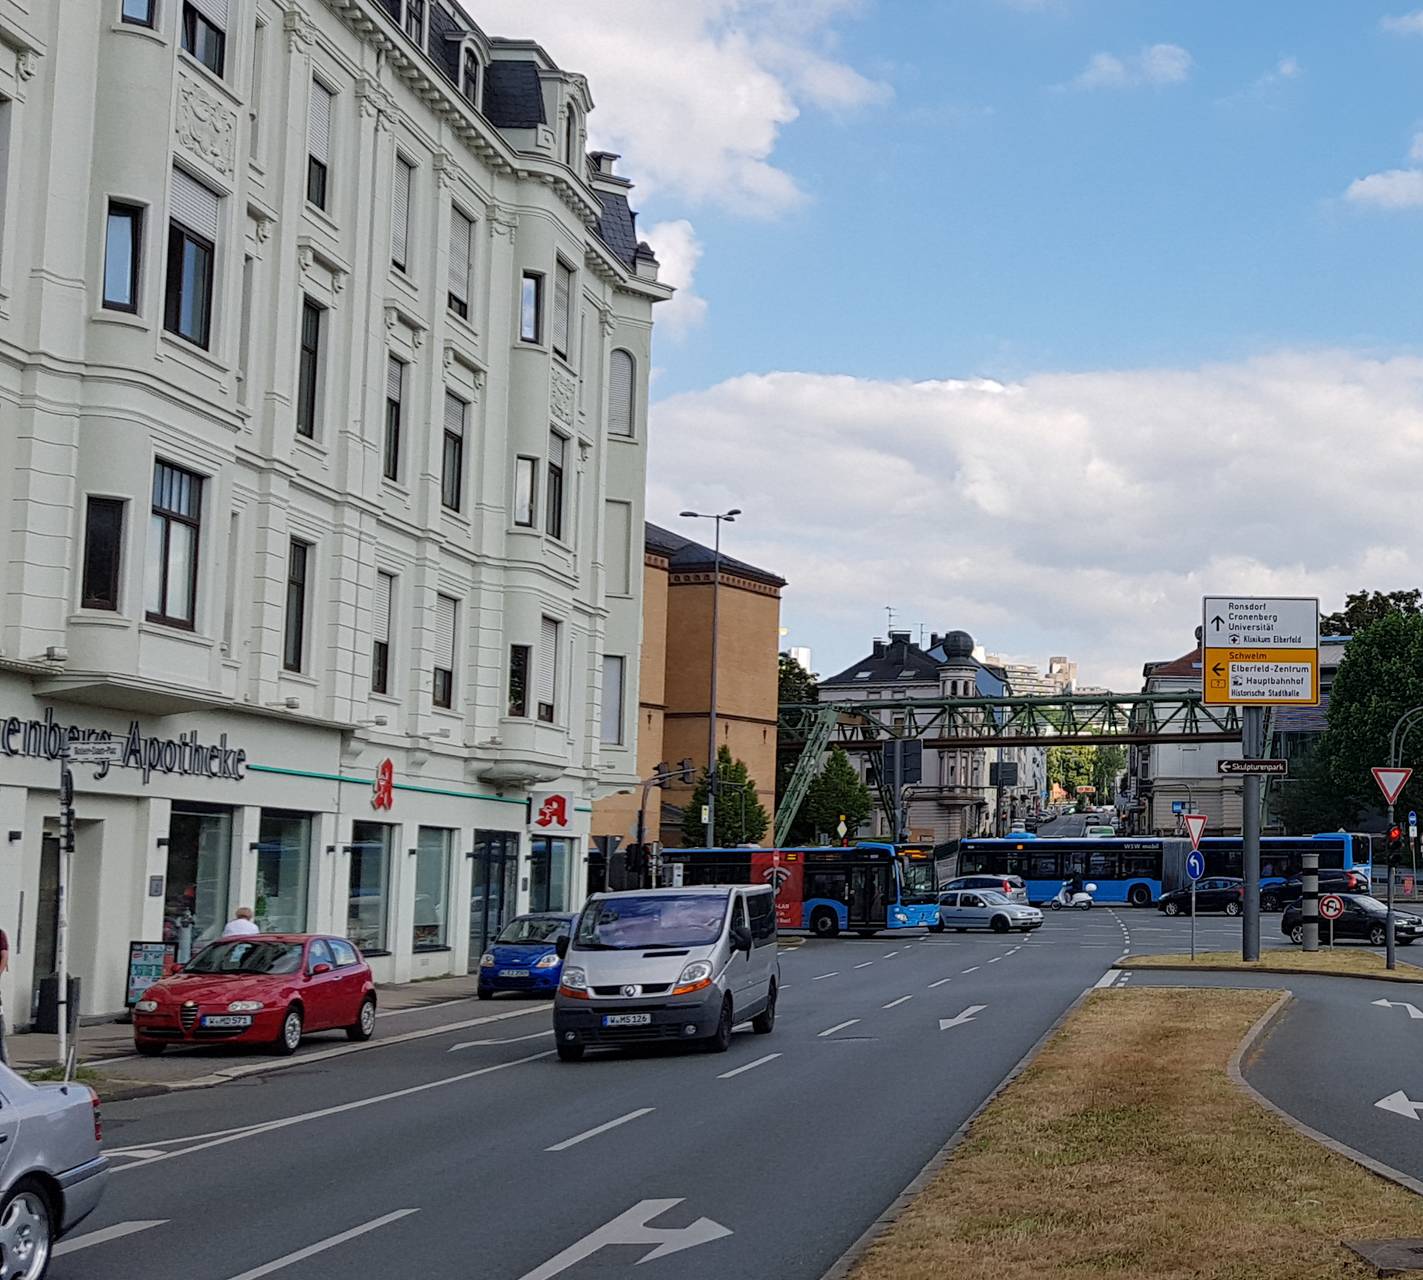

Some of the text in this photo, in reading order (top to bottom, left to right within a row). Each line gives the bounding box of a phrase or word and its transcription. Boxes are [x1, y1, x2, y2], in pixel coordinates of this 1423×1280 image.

[1228, 602, 1266, 611] Ronsdorf
[1228, 613, 1278, 622] Cronenberg
[1228, 622, 1274, 631] Universität
[1243, 635, 1302, 643] Klinikum Elberfeld
[1229, 651, 1267, 660] Schwelm
[1231, 664, 1309, 673] Elberfeld-Zentrum
[1246, 677, 1304, 686] Hauptbahnhof
[1231, 689, 1300, 697] Historische Stadthalle
[123, 720, 247, 785] Apotheke
[1231, 762, 1285, 772] Skulpturenpark
